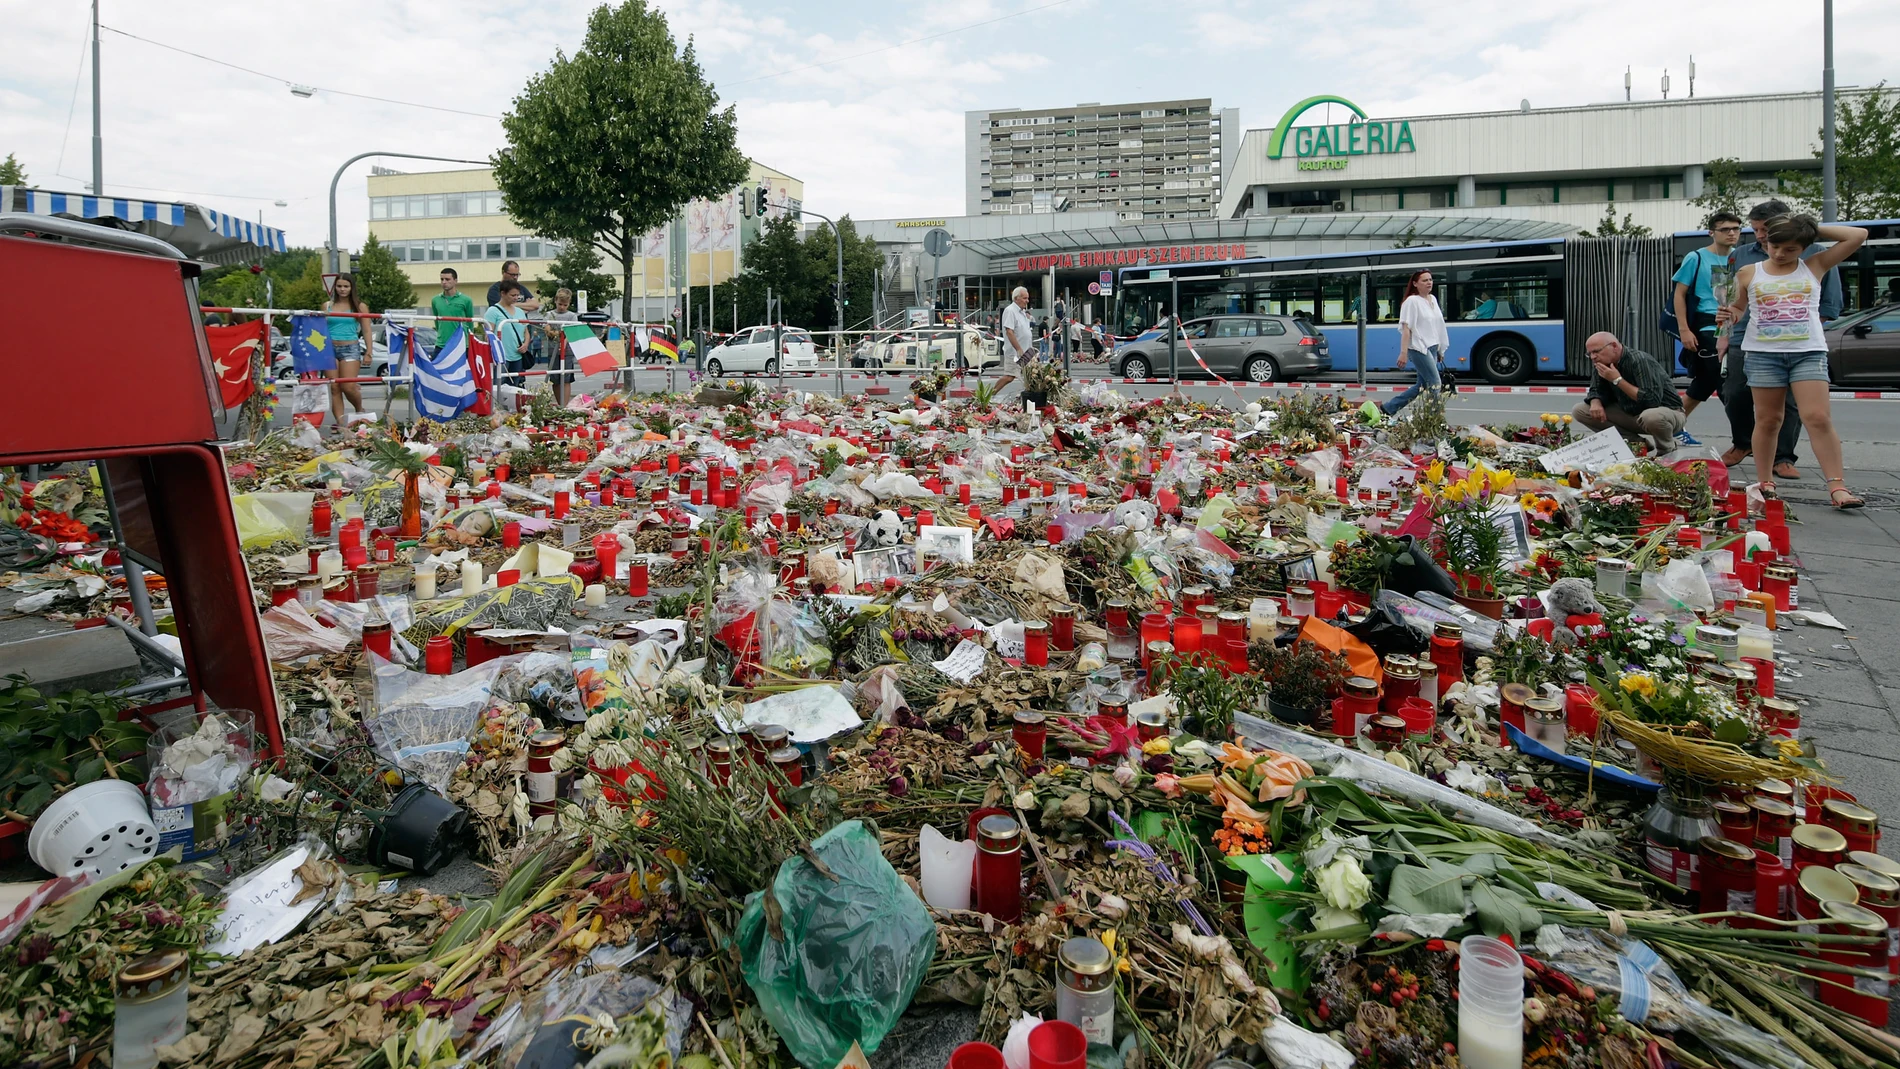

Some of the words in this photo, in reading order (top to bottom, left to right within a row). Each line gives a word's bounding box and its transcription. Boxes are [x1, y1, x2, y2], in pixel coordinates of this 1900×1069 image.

[1295, 120, 1416, 158] GALERIA
[895, 220, 946, 228] FAHRSCHULE
[1017, 253, 1073, 272] OLYMPIA
[1079, 244, 1247, 267] EINKAUFSZENTRUM
[250, 881, 290, 905] Herz
